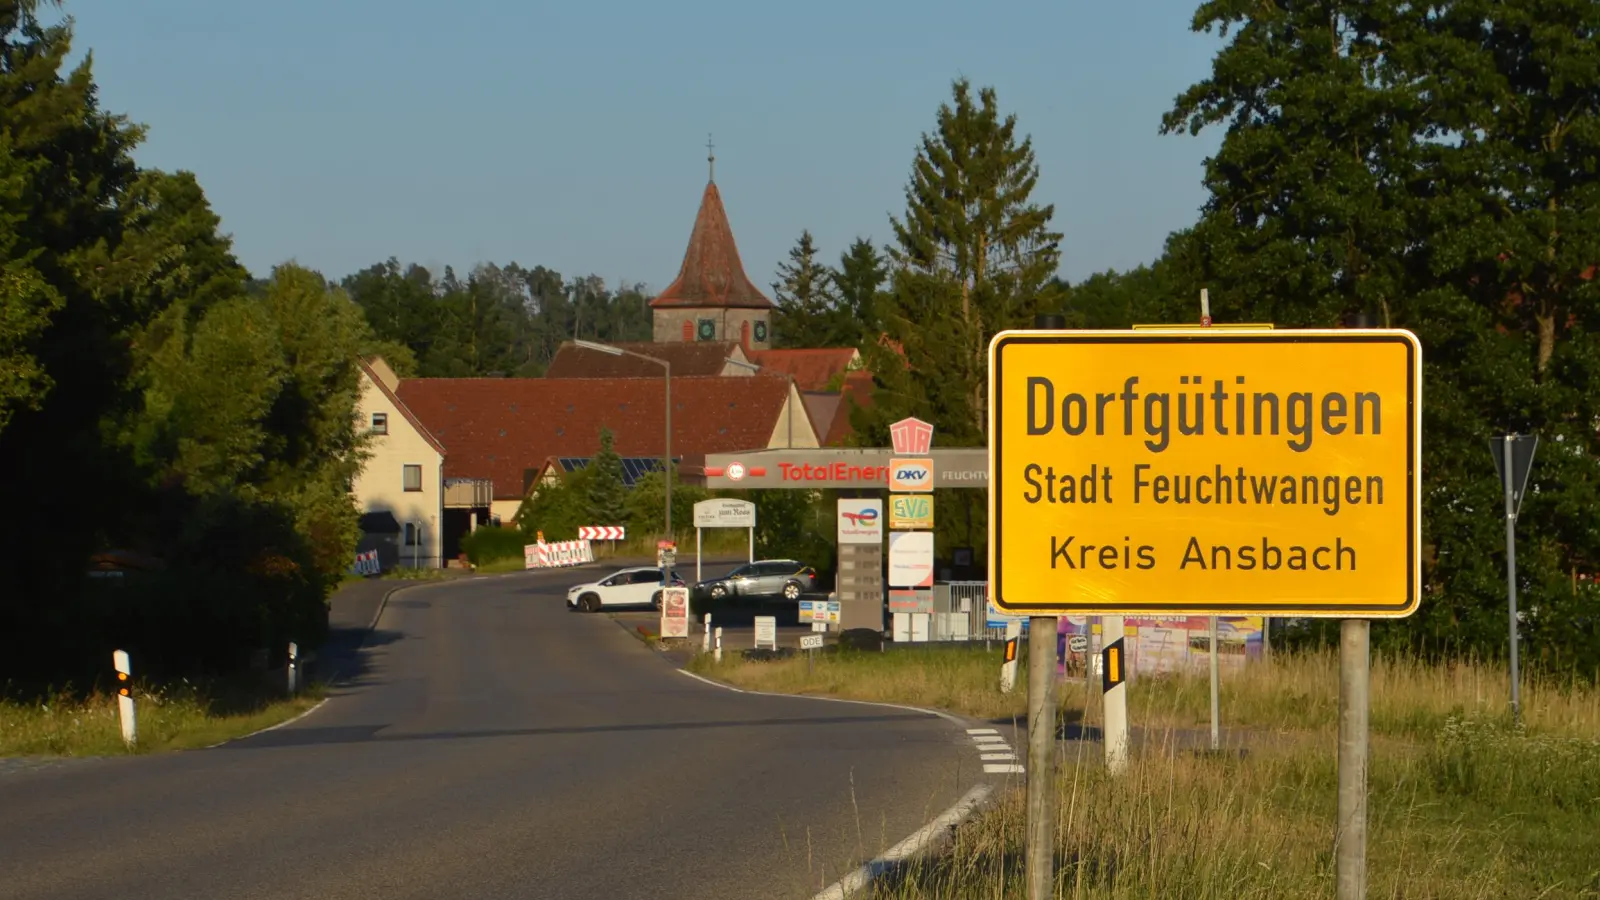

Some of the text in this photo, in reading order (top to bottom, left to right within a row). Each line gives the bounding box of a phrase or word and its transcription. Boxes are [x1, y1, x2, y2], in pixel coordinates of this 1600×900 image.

[1026, 375, 1382, 453] Dorfgütingen
[890, 417, 933, 454] UTA
[896, 470, 927, 480] DKV
[1023, 463, 1384, 516] Stadt Feuchtwangen
[894, 498, 929, 518] SVG
[1050, 535, 1357, 571] Kreis Ansbach
[803, 637, 820, 646] ODE
